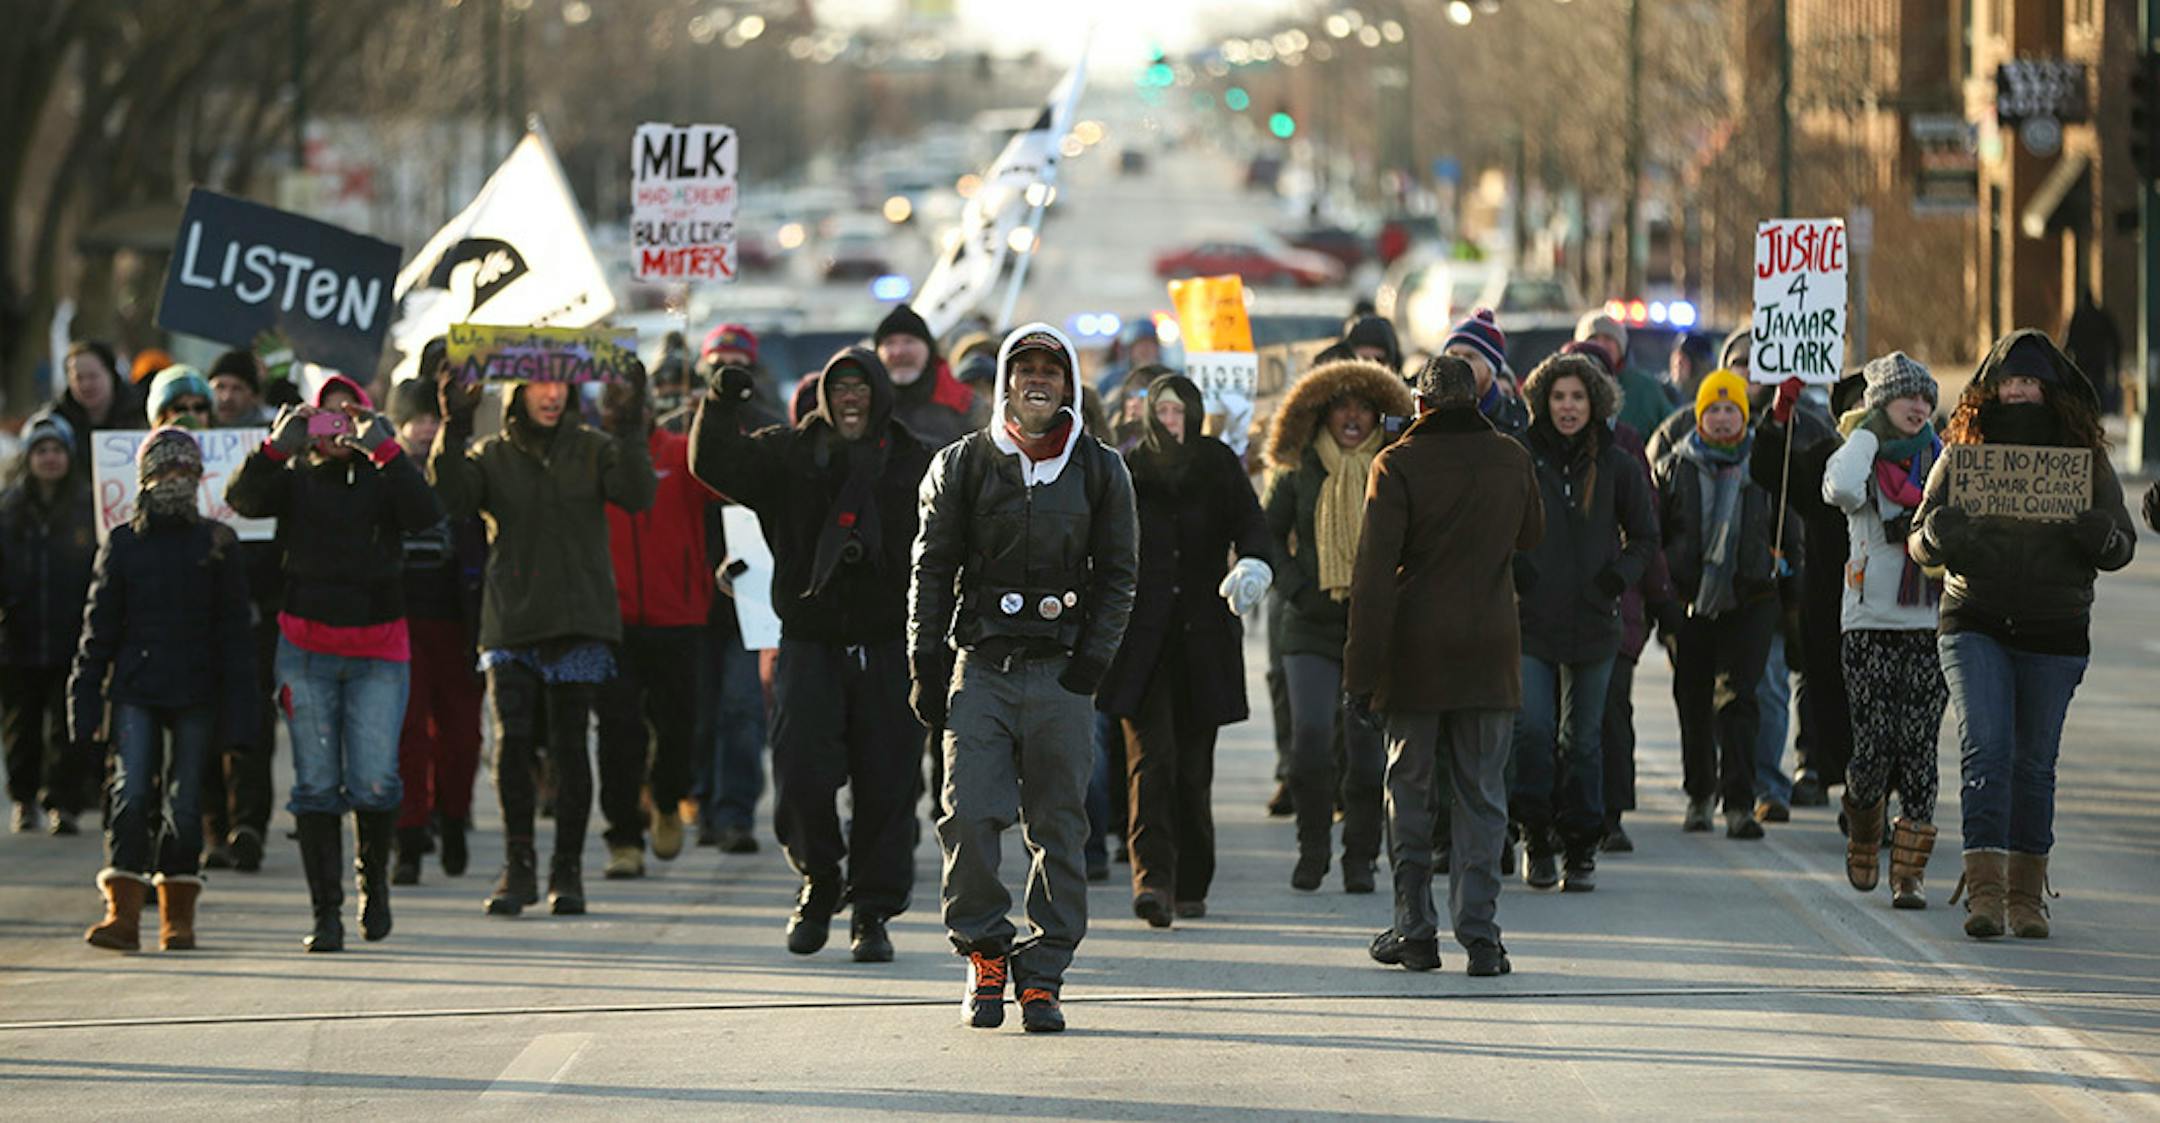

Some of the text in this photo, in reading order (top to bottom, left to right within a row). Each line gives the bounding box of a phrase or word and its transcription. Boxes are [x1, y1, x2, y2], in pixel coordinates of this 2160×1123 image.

[641, 132, 729, 182] MLK
[1787, 272, 1808, 310] 4
[1755, 302, 1838, 342] JAMAR
[1757, 341, 1836, 375] CLARK
[1956, 450, 2090, 479] IDLE NO MORE!
[1955, 472, 2086, 496] 4 JAMAR CLARK
